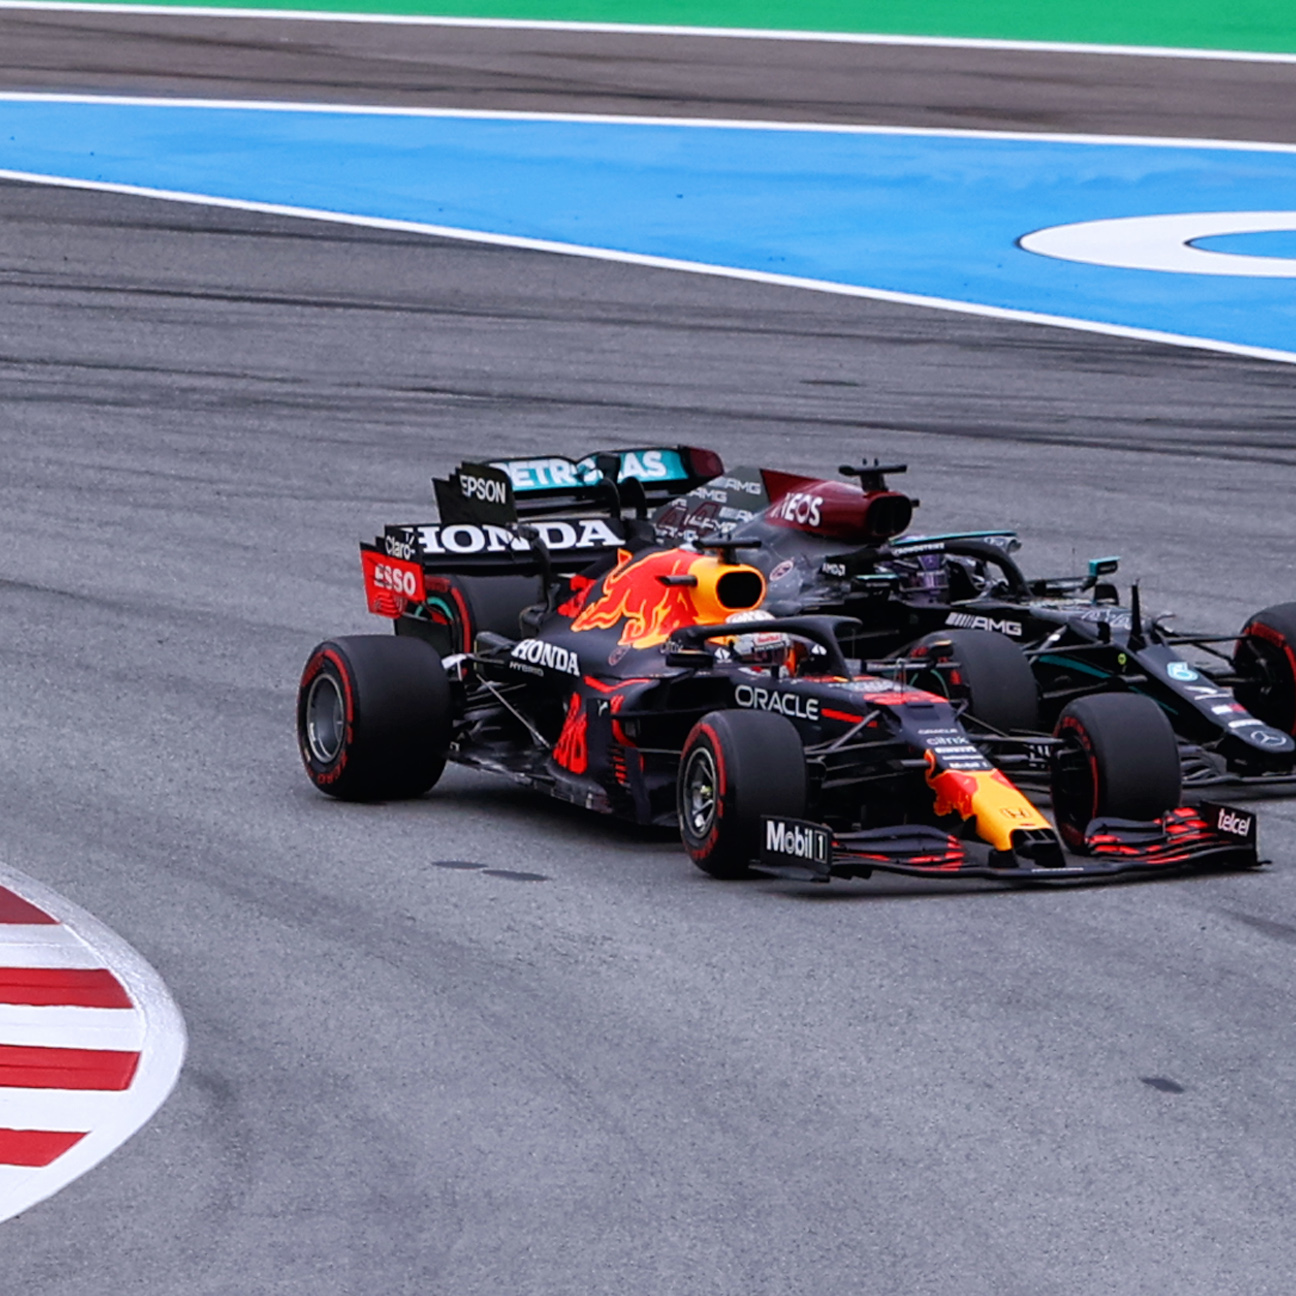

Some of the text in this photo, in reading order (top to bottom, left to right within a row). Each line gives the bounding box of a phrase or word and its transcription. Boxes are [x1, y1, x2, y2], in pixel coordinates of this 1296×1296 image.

[459, 475, 506, 505] EPSON
[404, 519, 625, 554] HONDA
[373, 564, 416, 595] ESSO
[971, 616, 1022, 636] AMG
[510, 638, 581, 677] HONDA
[734, 684, 820, 721] ORACLE
[766, 819, 813, 860] Mobil
[1217, 808, 1252, 838] telcel
